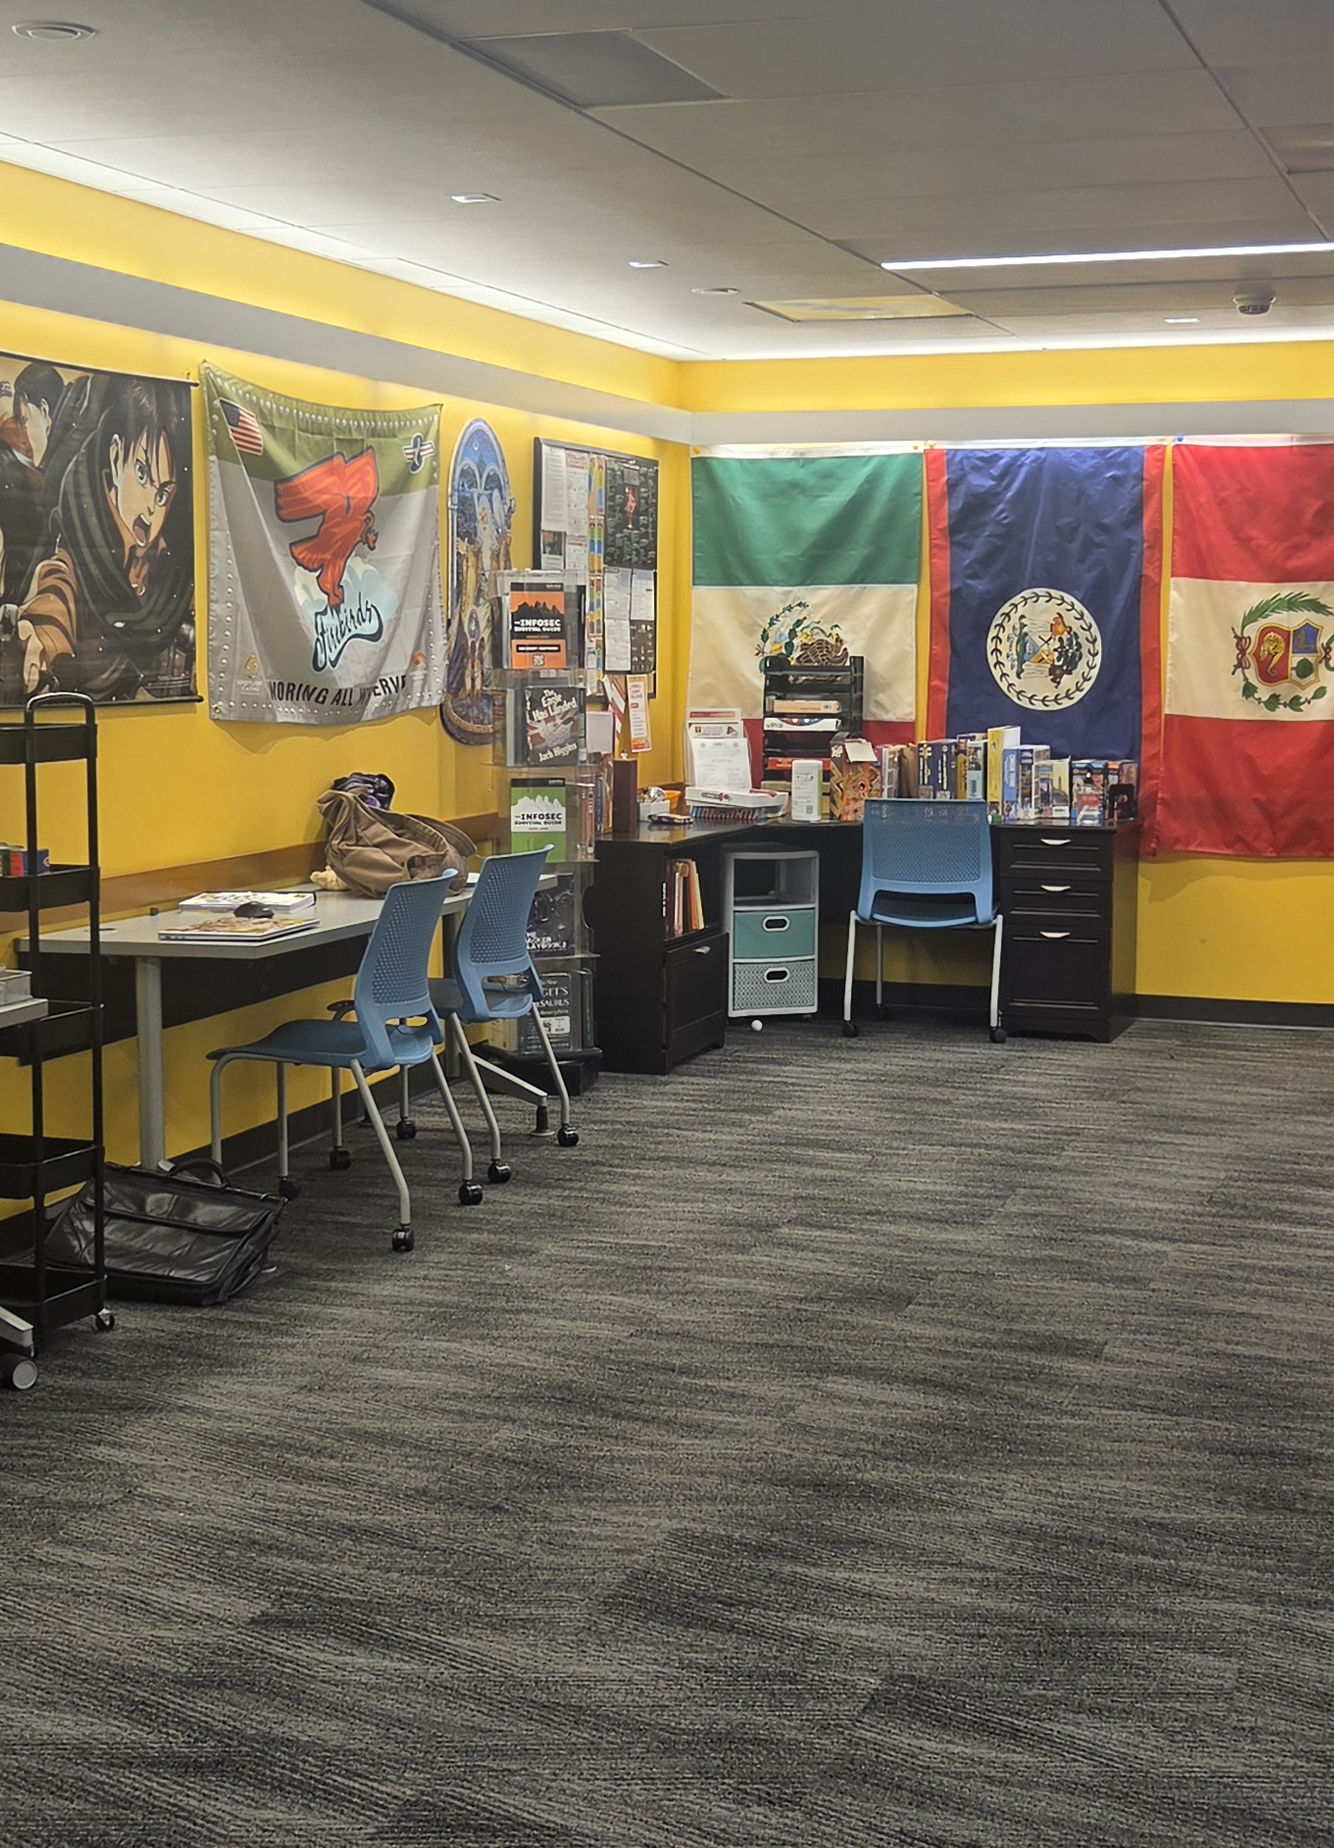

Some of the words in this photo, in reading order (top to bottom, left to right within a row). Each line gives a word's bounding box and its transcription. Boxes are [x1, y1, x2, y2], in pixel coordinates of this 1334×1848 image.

[520, 619, 562, 627] INFOSEC
[330, 688, 354, 706] ALL
[541, 694, 562, 708] Eagle
[532, 710, 548, 721] Has
[548, 697, 578, 716] Landed
[539, 750, 554, 762] Jack
[552, 743, 578, 756] Higgins
[542, 986, 569, 998] GET'S
